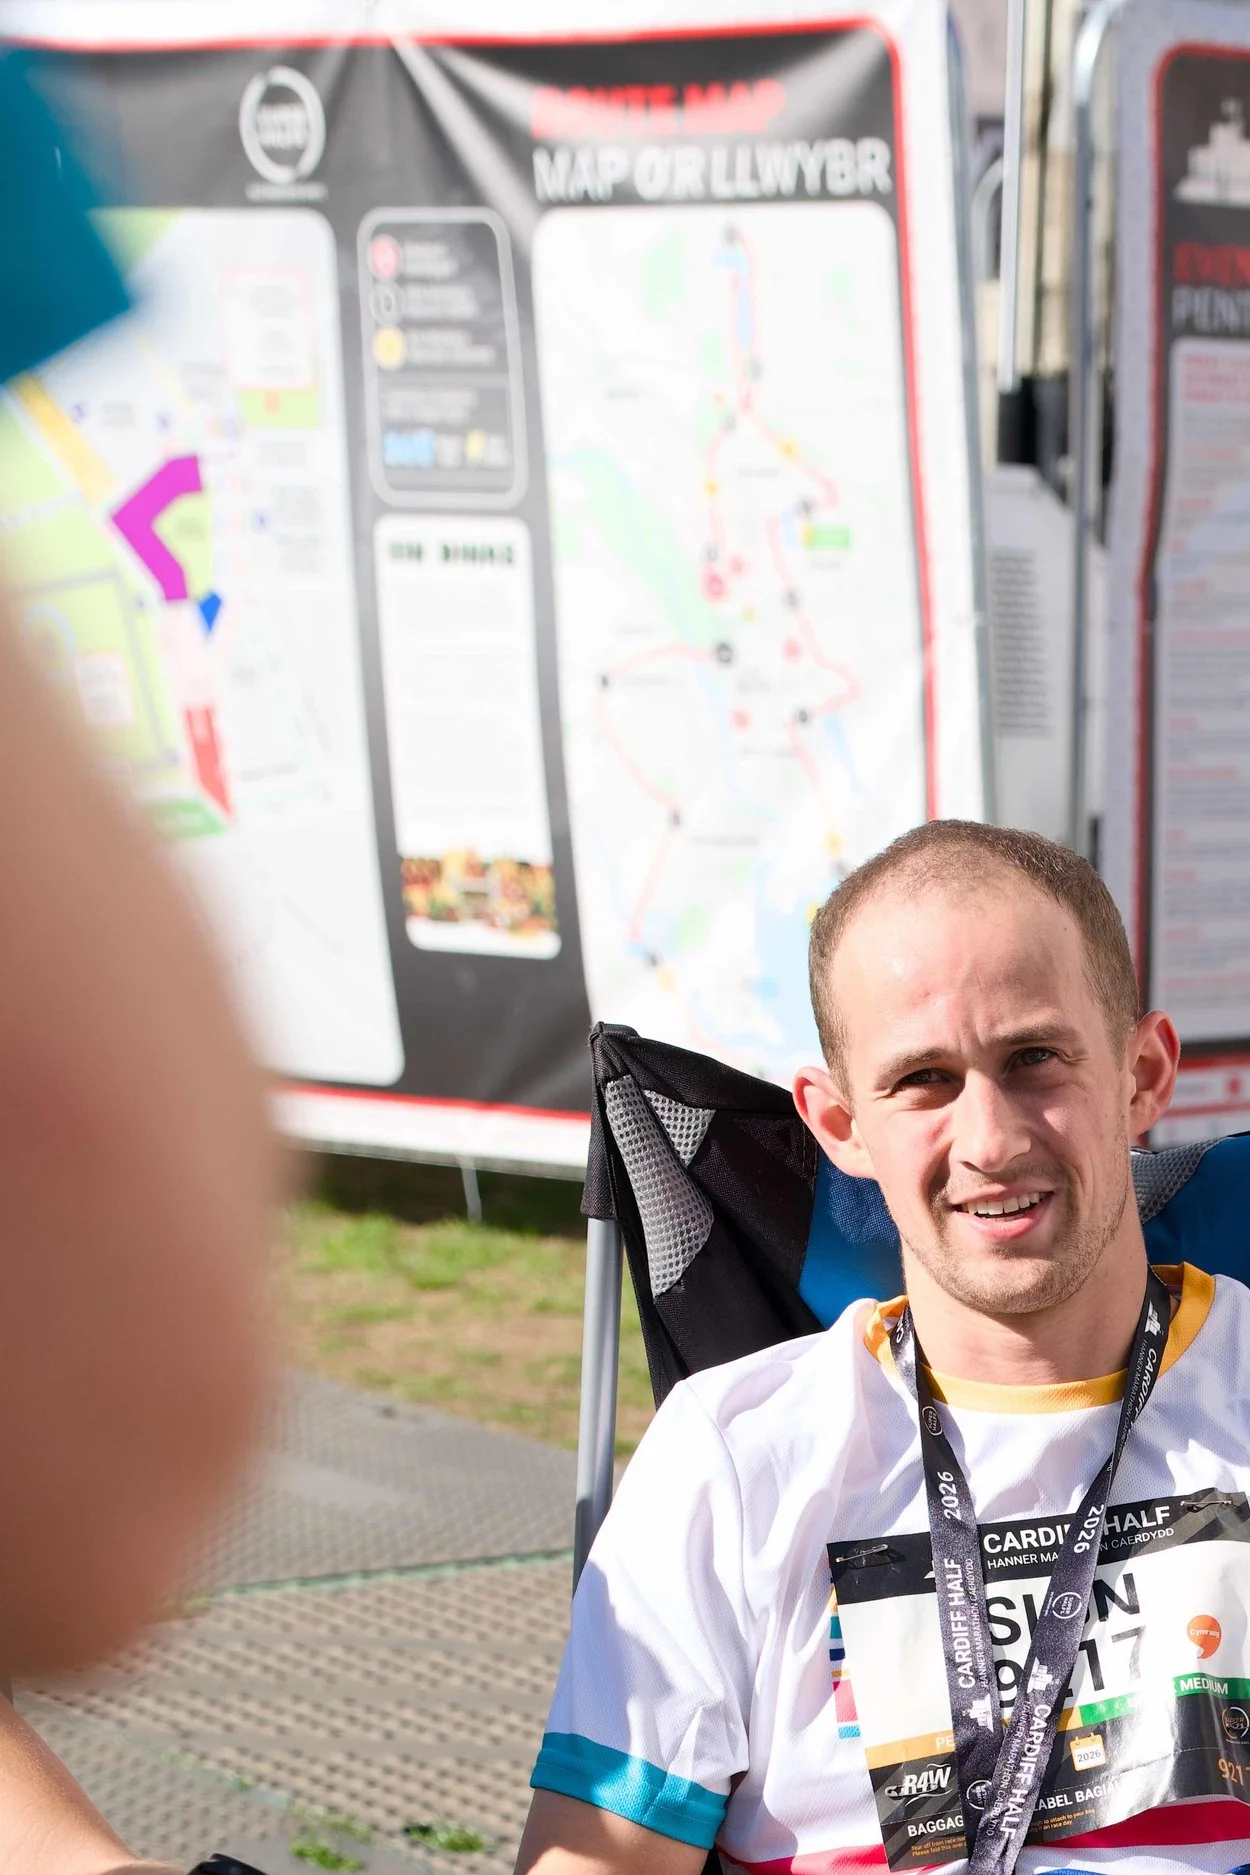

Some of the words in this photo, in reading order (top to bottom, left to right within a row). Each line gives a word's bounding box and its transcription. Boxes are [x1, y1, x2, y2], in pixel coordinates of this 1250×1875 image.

[532, 146, 629, 202] MAP
[632, 144, 708, 199] O'R
[711, 138, 892, 199] LLWYBR
[937, 1471, 961, 1520] 2026
[983, 1524, 1071, 1553] CARDI
[1102, 1506, 1170, 1535] HALF
[987, 1553, 1038, 1570] HANNER
[1111, 1528, 1174, 1551] CAERDYDD
[1074, 1504, 1104, 1554] 2026
[944, 1557, 967, 1605] HALF
[969, 1603, 985, 1650] MARATHON
[988, 1573, 1140, 1646] SIN
[950, 1611, 976, 1689] CARDIFF
[1189, 1628, 1220, 1639] Cymraeg
[975, 1650, 989, 1688] HANNER
[994, 1625, 1146, 1708] 917
[1180, 1679, 1228, 1695] MEDIUM
[1001, 1738, 1023, 1790] MARATHON
[1018, 1704, 1051, 1785] CARDIFF
[1077, 1750, 1101, 1763] 2026
[902, 1766, 951, 1796] R4W
[908, 1815, 964, 1837] BAGGAG
[1000, 1789, 1029, 1840] HALF
[1049, 1815, 1066, 1823] attach
[912, 1849, 930, 1857] Please
